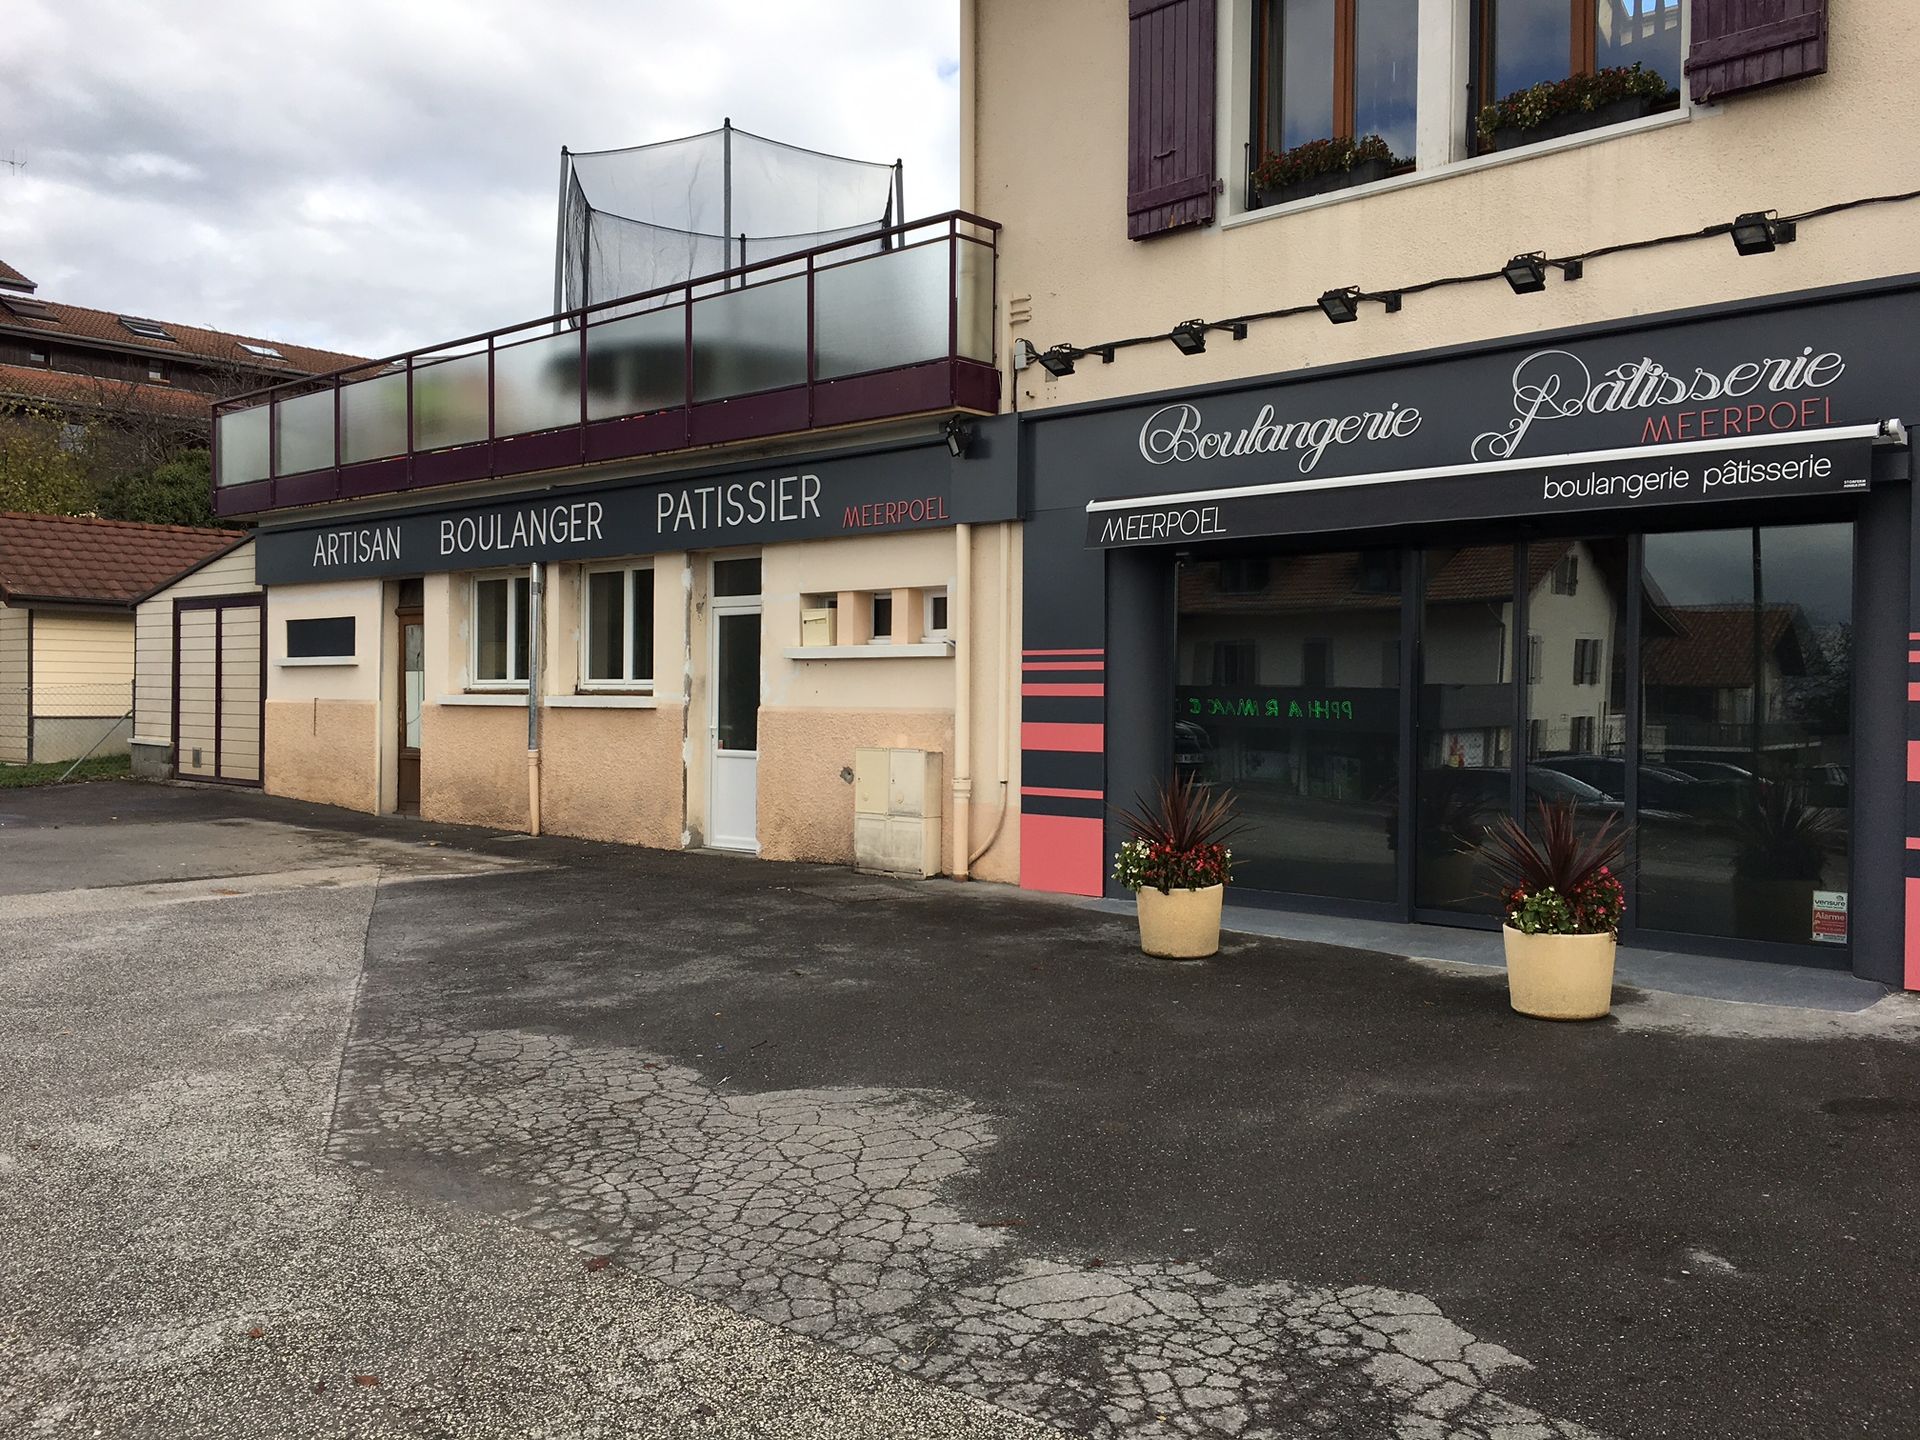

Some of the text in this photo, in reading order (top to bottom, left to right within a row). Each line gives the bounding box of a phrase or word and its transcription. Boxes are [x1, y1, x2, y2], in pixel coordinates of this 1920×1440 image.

[1470, 345, 1846, 463] Pâtisserie
[1641, 396, 1842, 443] MEERPOEL
[1138, 402, 1422, 474] Boulangerie
[1543, 453, 1832, 500] boulangerie pâtisserie
[312, 473, 950, 567] ARTISAN BOULANGER PATISSIER MEERPOEL
[1100, 506, 1227, 544] MEERPOEL
[1815, 911, 1846, 921] Alarme
